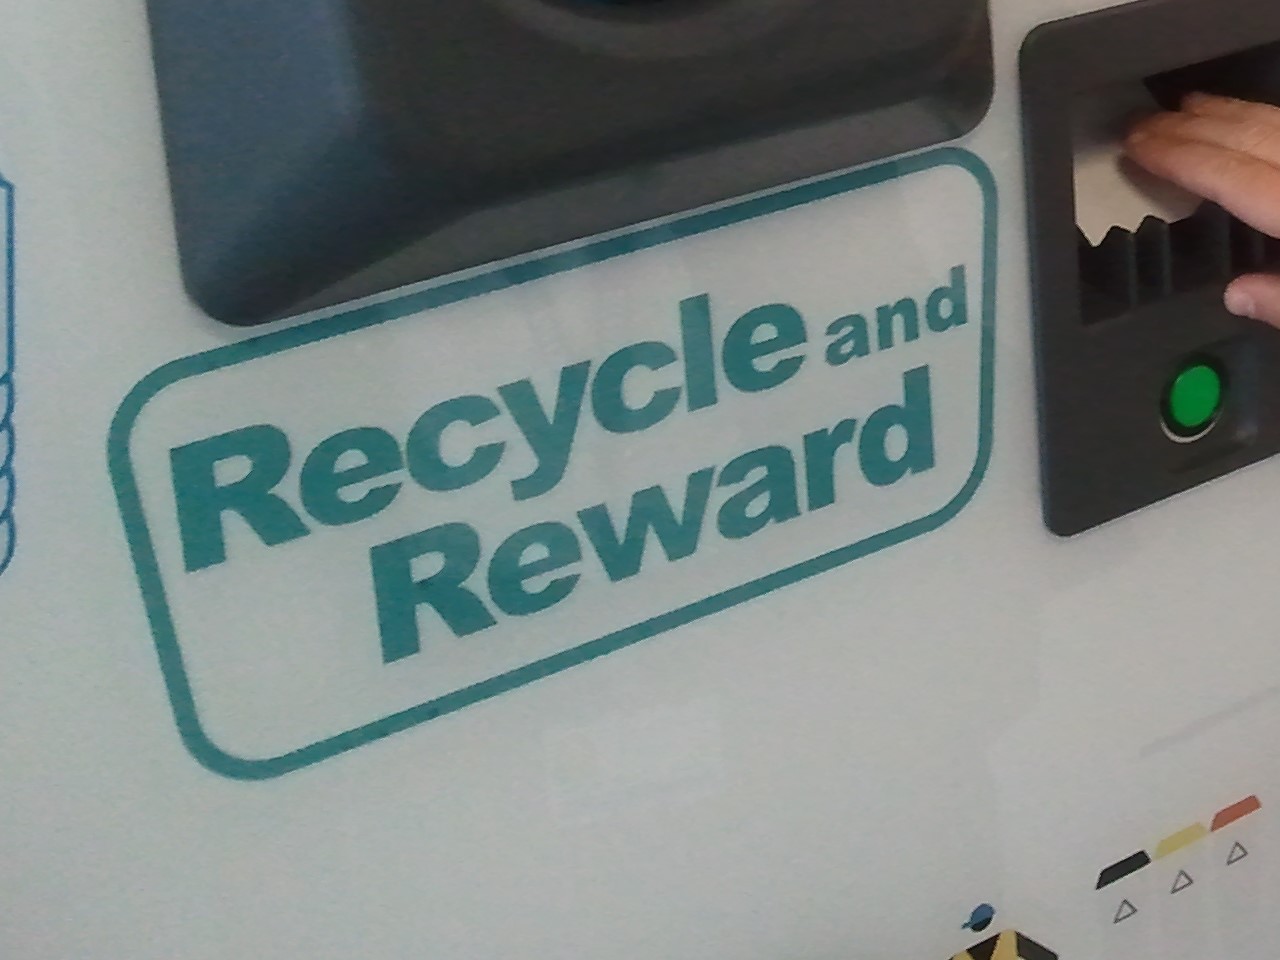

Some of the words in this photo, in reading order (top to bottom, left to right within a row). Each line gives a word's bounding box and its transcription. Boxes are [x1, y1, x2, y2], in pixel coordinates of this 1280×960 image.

[168, 292, 808, 574] Recycle
[823, 265, 970, 367] and
[369, 365, 938, 665] Reward
